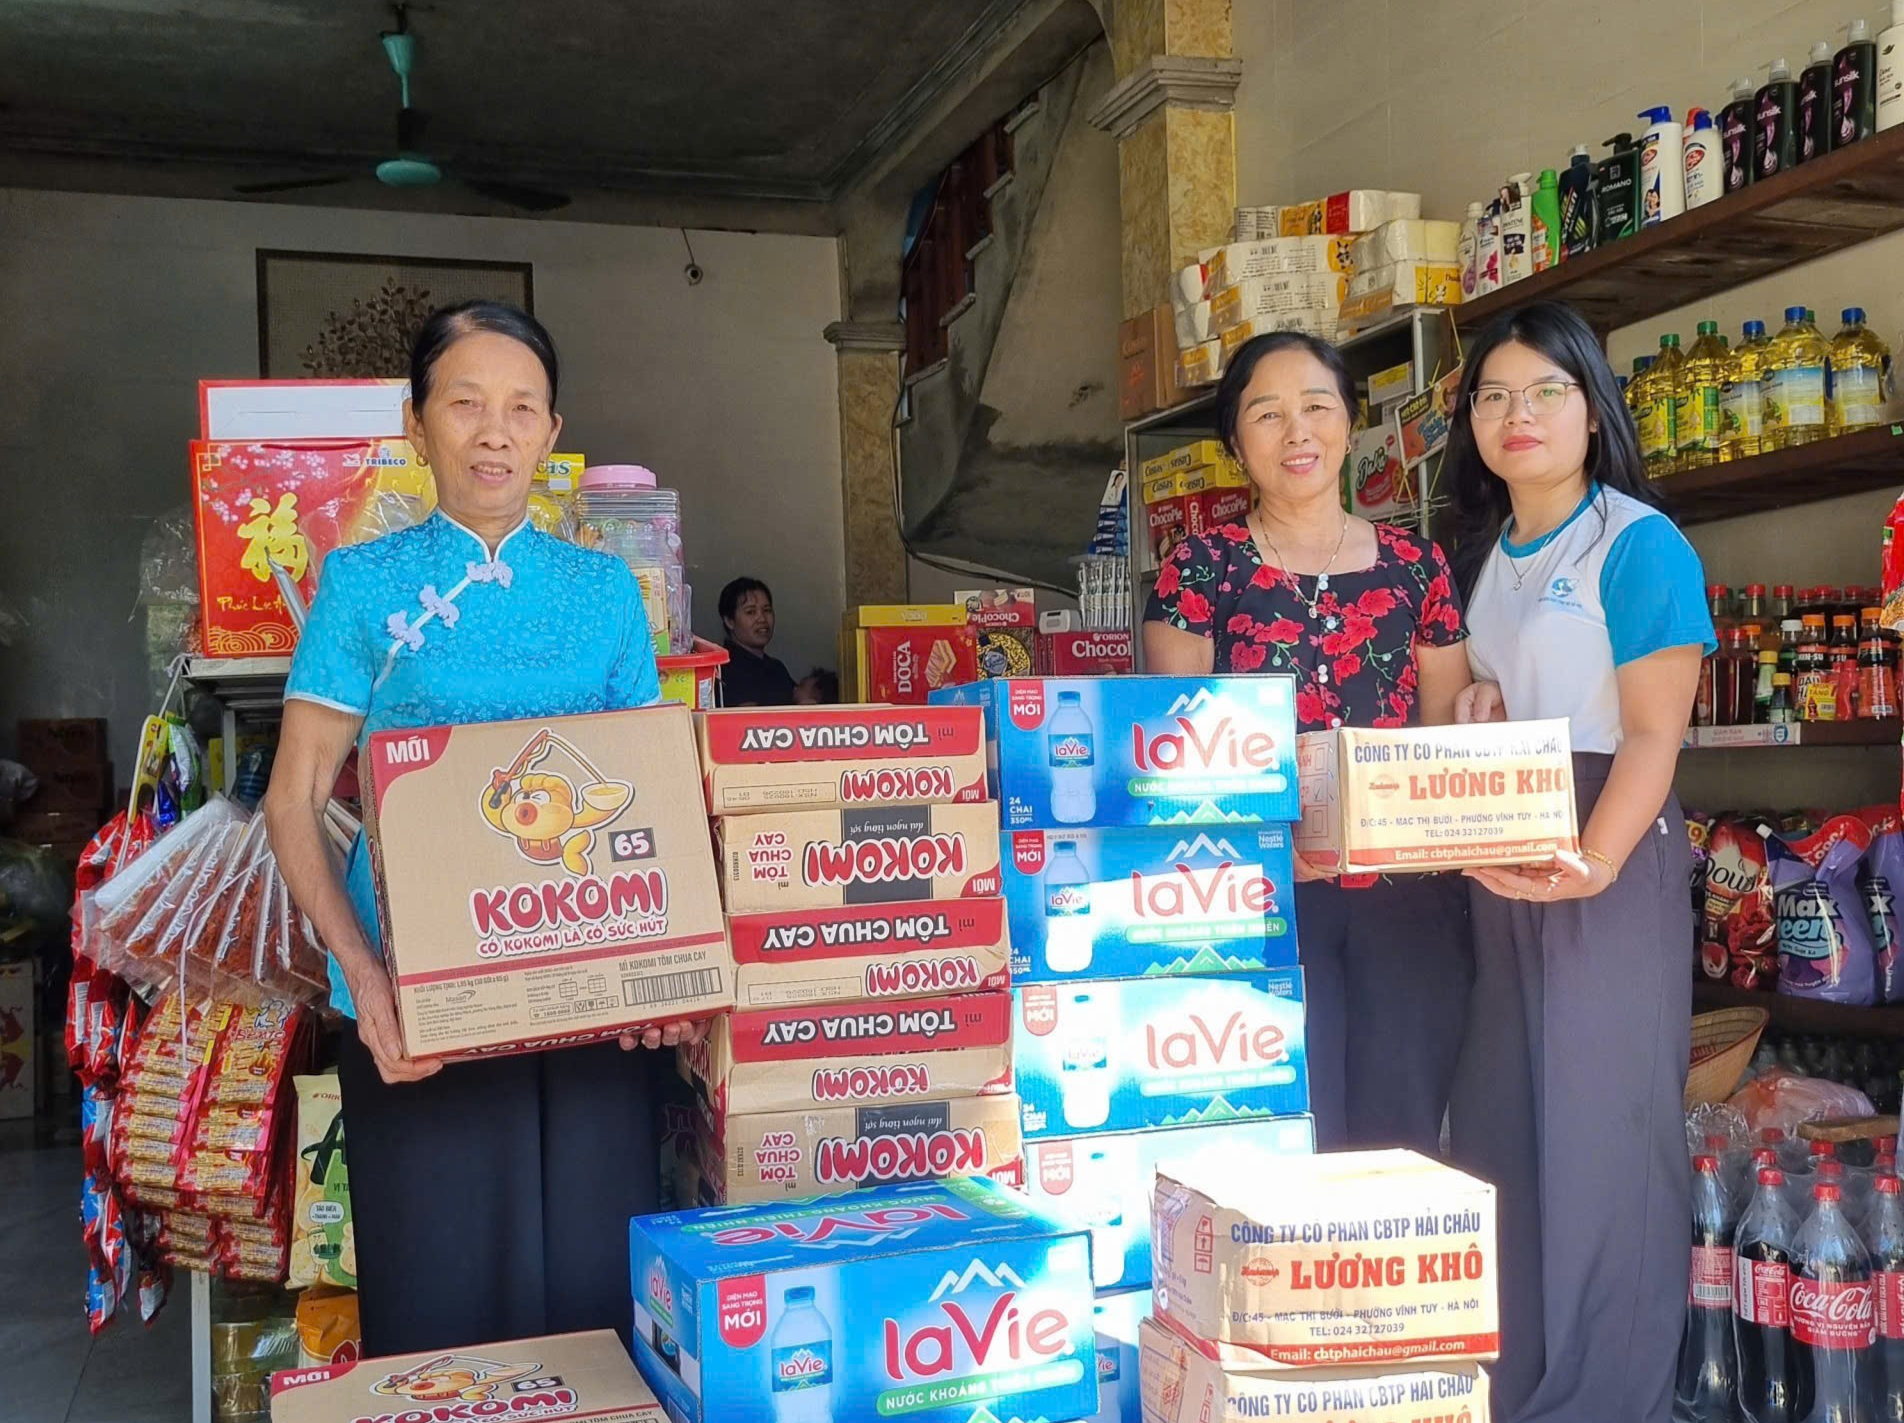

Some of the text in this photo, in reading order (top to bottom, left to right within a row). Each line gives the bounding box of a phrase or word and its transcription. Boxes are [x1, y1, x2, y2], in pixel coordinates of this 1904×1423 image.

[1600, 178, 1632, 193] ROMANO
[365, 457, 406, 466] TRIBECO
[1149, 507, 1183, 528] ChocoPie
[1189, 502, 1200, 535] Choco
[972, 612, 1020, 624] ChocoPie
[897, 641, 913, 694] DOCA
[1013, 701, 1041, 716] MỚI
[740, 723, 930, 750] TÔM CHUA CAY
[1132, 716, 1275, 772] laVie
[386, 736, 430, 764] MỚI
[1055, 743, 1088, 757] laVie
[1354, 741, 1409, 763] CÔNG TY
[841, 766, 955, 802] KOKOMI
[1409, 767, 1506, 800] LƯƠNG
[1009, 796, 1021, 804] 24
[1009, 806, 1033, 814] CHAI
[910, 822, 924, 832] dai
[1425, 827, 1504, 838] TEL: 024 32127039
[613, 831, 650, 857] 65
[755, 833, 785, 846] CAY
[1258, 833, 1284, 843] Nestlé
[1259, 841, 1284, 849] Waters
[749, 850, 791, 862] CHUA
[804, 832, 967, 887] KOKOMI
[1016, 850, 1042, 863] MỚI
[1395, 841, 1558, 861] Email: cbtphaichau@gmail.com
[753, 866, 788, 881] TÔM
[973, 878, 996, 893] MỚI
[1132, 861, 1275, 917] laVie
[471, 869, 667, 936] KOKOMI
[1778, 894, 1840, 918] Max
[479, 918, 664, 954] CÓ KOKOMI LÀ CÓ SỨC HÚT
[762, 915, 951, 950] TÔM CHUA CAY
[618, 951, 707, 971] MÌ KOKOMI TÔM CHUA CAY
[866, 955, 981, 996] KOKOMI
[1269, 979, 1293, 989] Nestlé
[762, 1008, 957, 1045] TÔM CHUA CAY
[523, 1032, 596, 1049] CHUA
[1145, 1011, 1286, 1070] laVie
[813, 1062, 930, 1100] KOKOMI
[928, 1117, 943, 1129] dai
[762, 1133, 795, 1147] CAY
[756, 1149, 800, 1163] CHUA
[815, 1129, 989, 1185] KOKOMI
[761, 1166, 797, 1183] TÔM
[712, 1203, 970, 1246] laVie
[1230, 1207, 1481, 1244] CÔNG TY CBTP HẢI CHÂU
[1290, 1242, 1483, 1290] LƯƠNG KHÔ
[1755, 1263, 1786, 1275] Coca-Cola
[650, 1269, 672, 1311] laVie
[722, 1299, 763, 1310] SANG TRỌNG
[1420, 1303, 1438, 1314] TUY
[1790, 1281, 1874, 1322] Coca-Cola
[724, 1308, 761, 1330] MỚI
[884, 1292, 1069, 1380] laVie
[1309, 1322, 1405, 1337] TEL: 024 32127039
[1270, 1339, 1465, 1362] Email: cbtphaichau@gmail.com
[780, 1351, 826, 1377] laVie
[283, 1370, 331, 1386] MỚI
[517, 1378, 553, 1389] 65
[886, 1391, 925, 1410] NƯỚC
[1274, 1393, 1292, 1415] TY
[1369, 1384, 1405, 1407] CBTP
[508, 1403, 573, 1420] SỨC HÚT
[610, 1413, 634, 1421] CHUA
[636, 1410, 653, 1418] CAY
